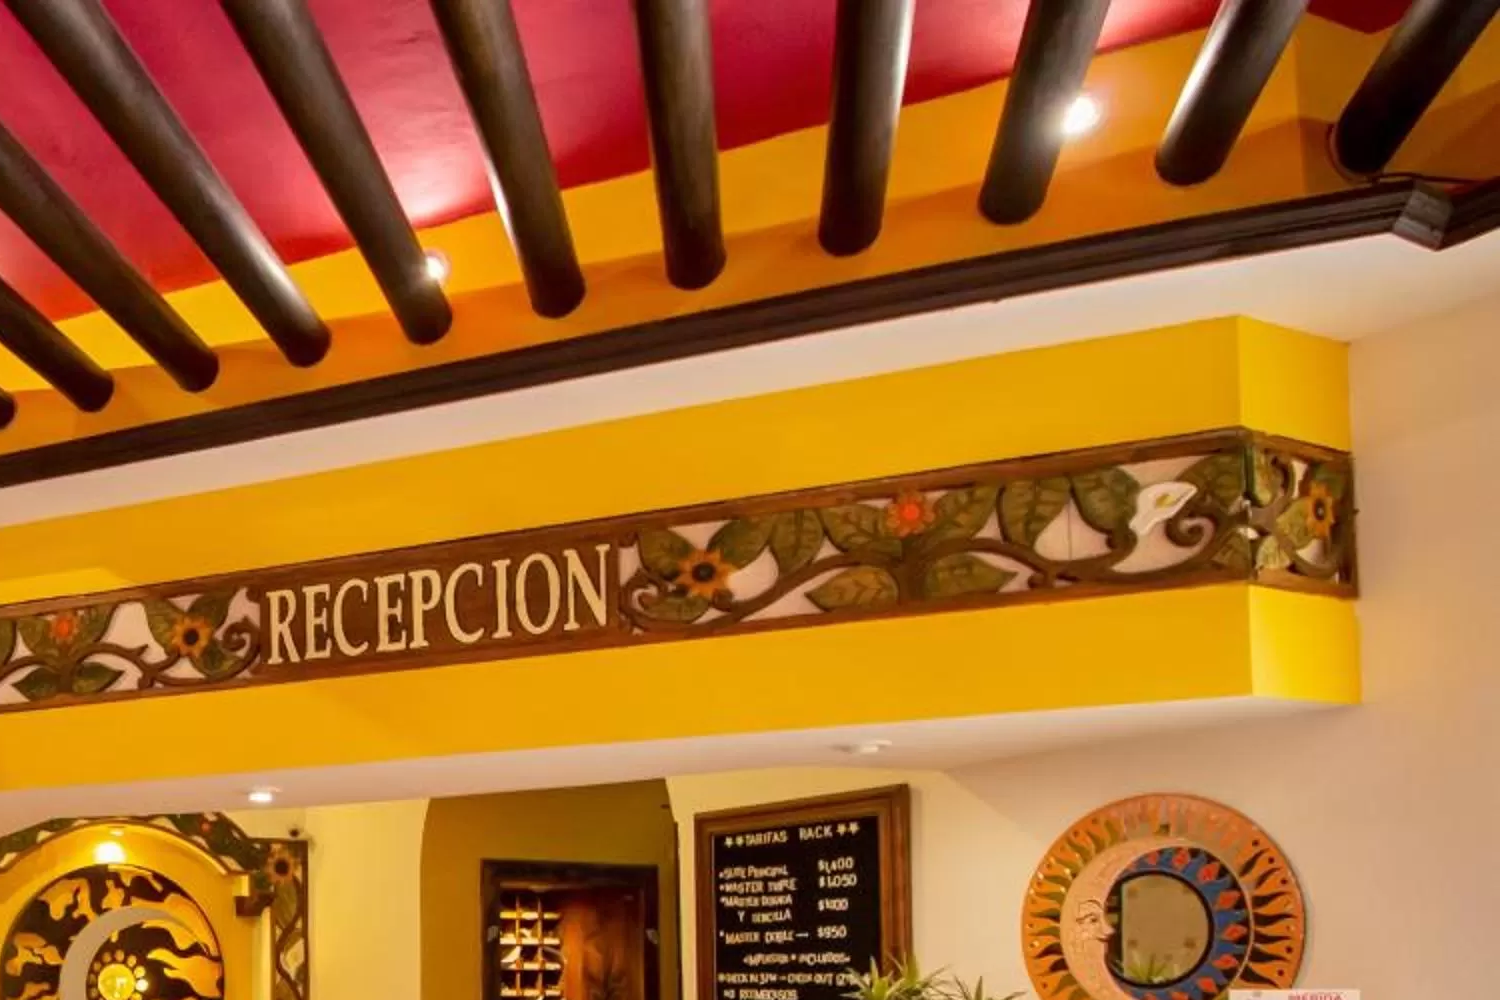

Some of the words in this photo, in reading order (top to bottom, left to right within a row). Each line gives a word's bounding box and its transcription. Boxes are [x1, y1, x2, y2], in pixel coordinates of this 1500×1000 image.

[265, 543, 611, 665] RECEPCION
[745, 830, 788, 847] TARIFAS
[799, 825, 833, 840] RACK
[737, 910, 745, 923] Y
[817, 925, 847, 939] $950
